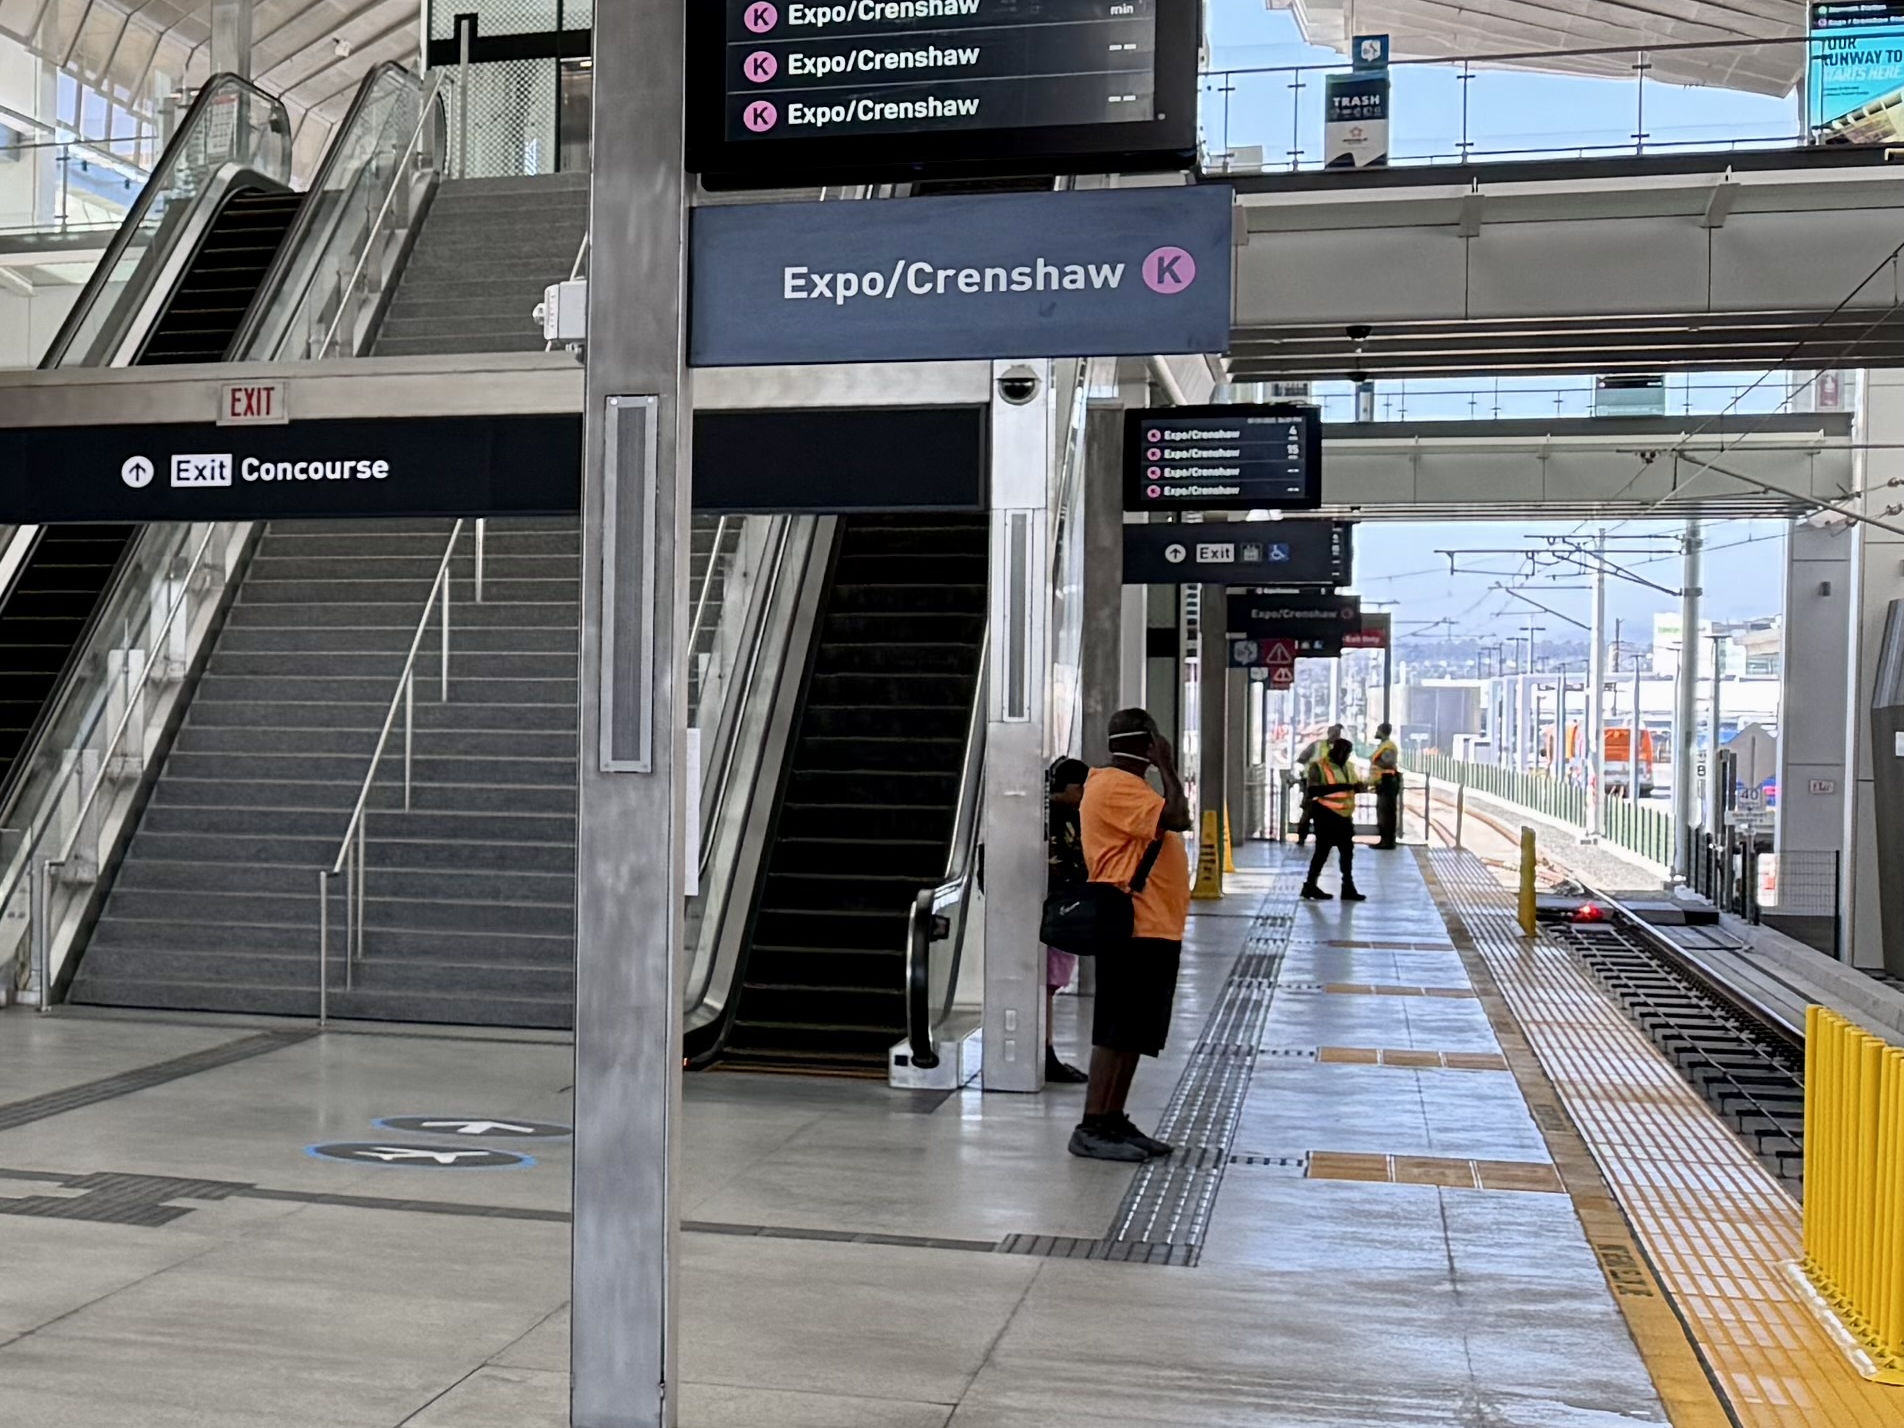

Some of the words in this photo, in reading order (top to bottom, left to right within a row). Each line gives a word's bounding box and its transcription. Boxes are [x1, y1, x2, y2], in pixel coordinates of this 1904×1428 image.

[754, 7, 769, 27] K
[1110, 3, 1134, 16] min
[753, 57, 769, 77] K
[787, 45, 980, 77] Expo/Crenshaw
[1886, 49, 1903, 64] TO
[1333, 94, 1380, 107] TRASH
[753, 106, 768, 127] K
[787, 95, 980, 127] Expo/Crenshaw
[784, 257, 1125, 305] Expo/Crenshaw
[1156, 256, 1182, 284] K
[231, 386, 275, 418] EXIT
[1287, 444, 1299, 454] 15
[176, 459, 227, 482] Exit
[241, 457, 389, 482] Concourse
[1199, 546, 1230, 560] Exit
[1251, 608, 1337, 619] Expo/Crenshaw
